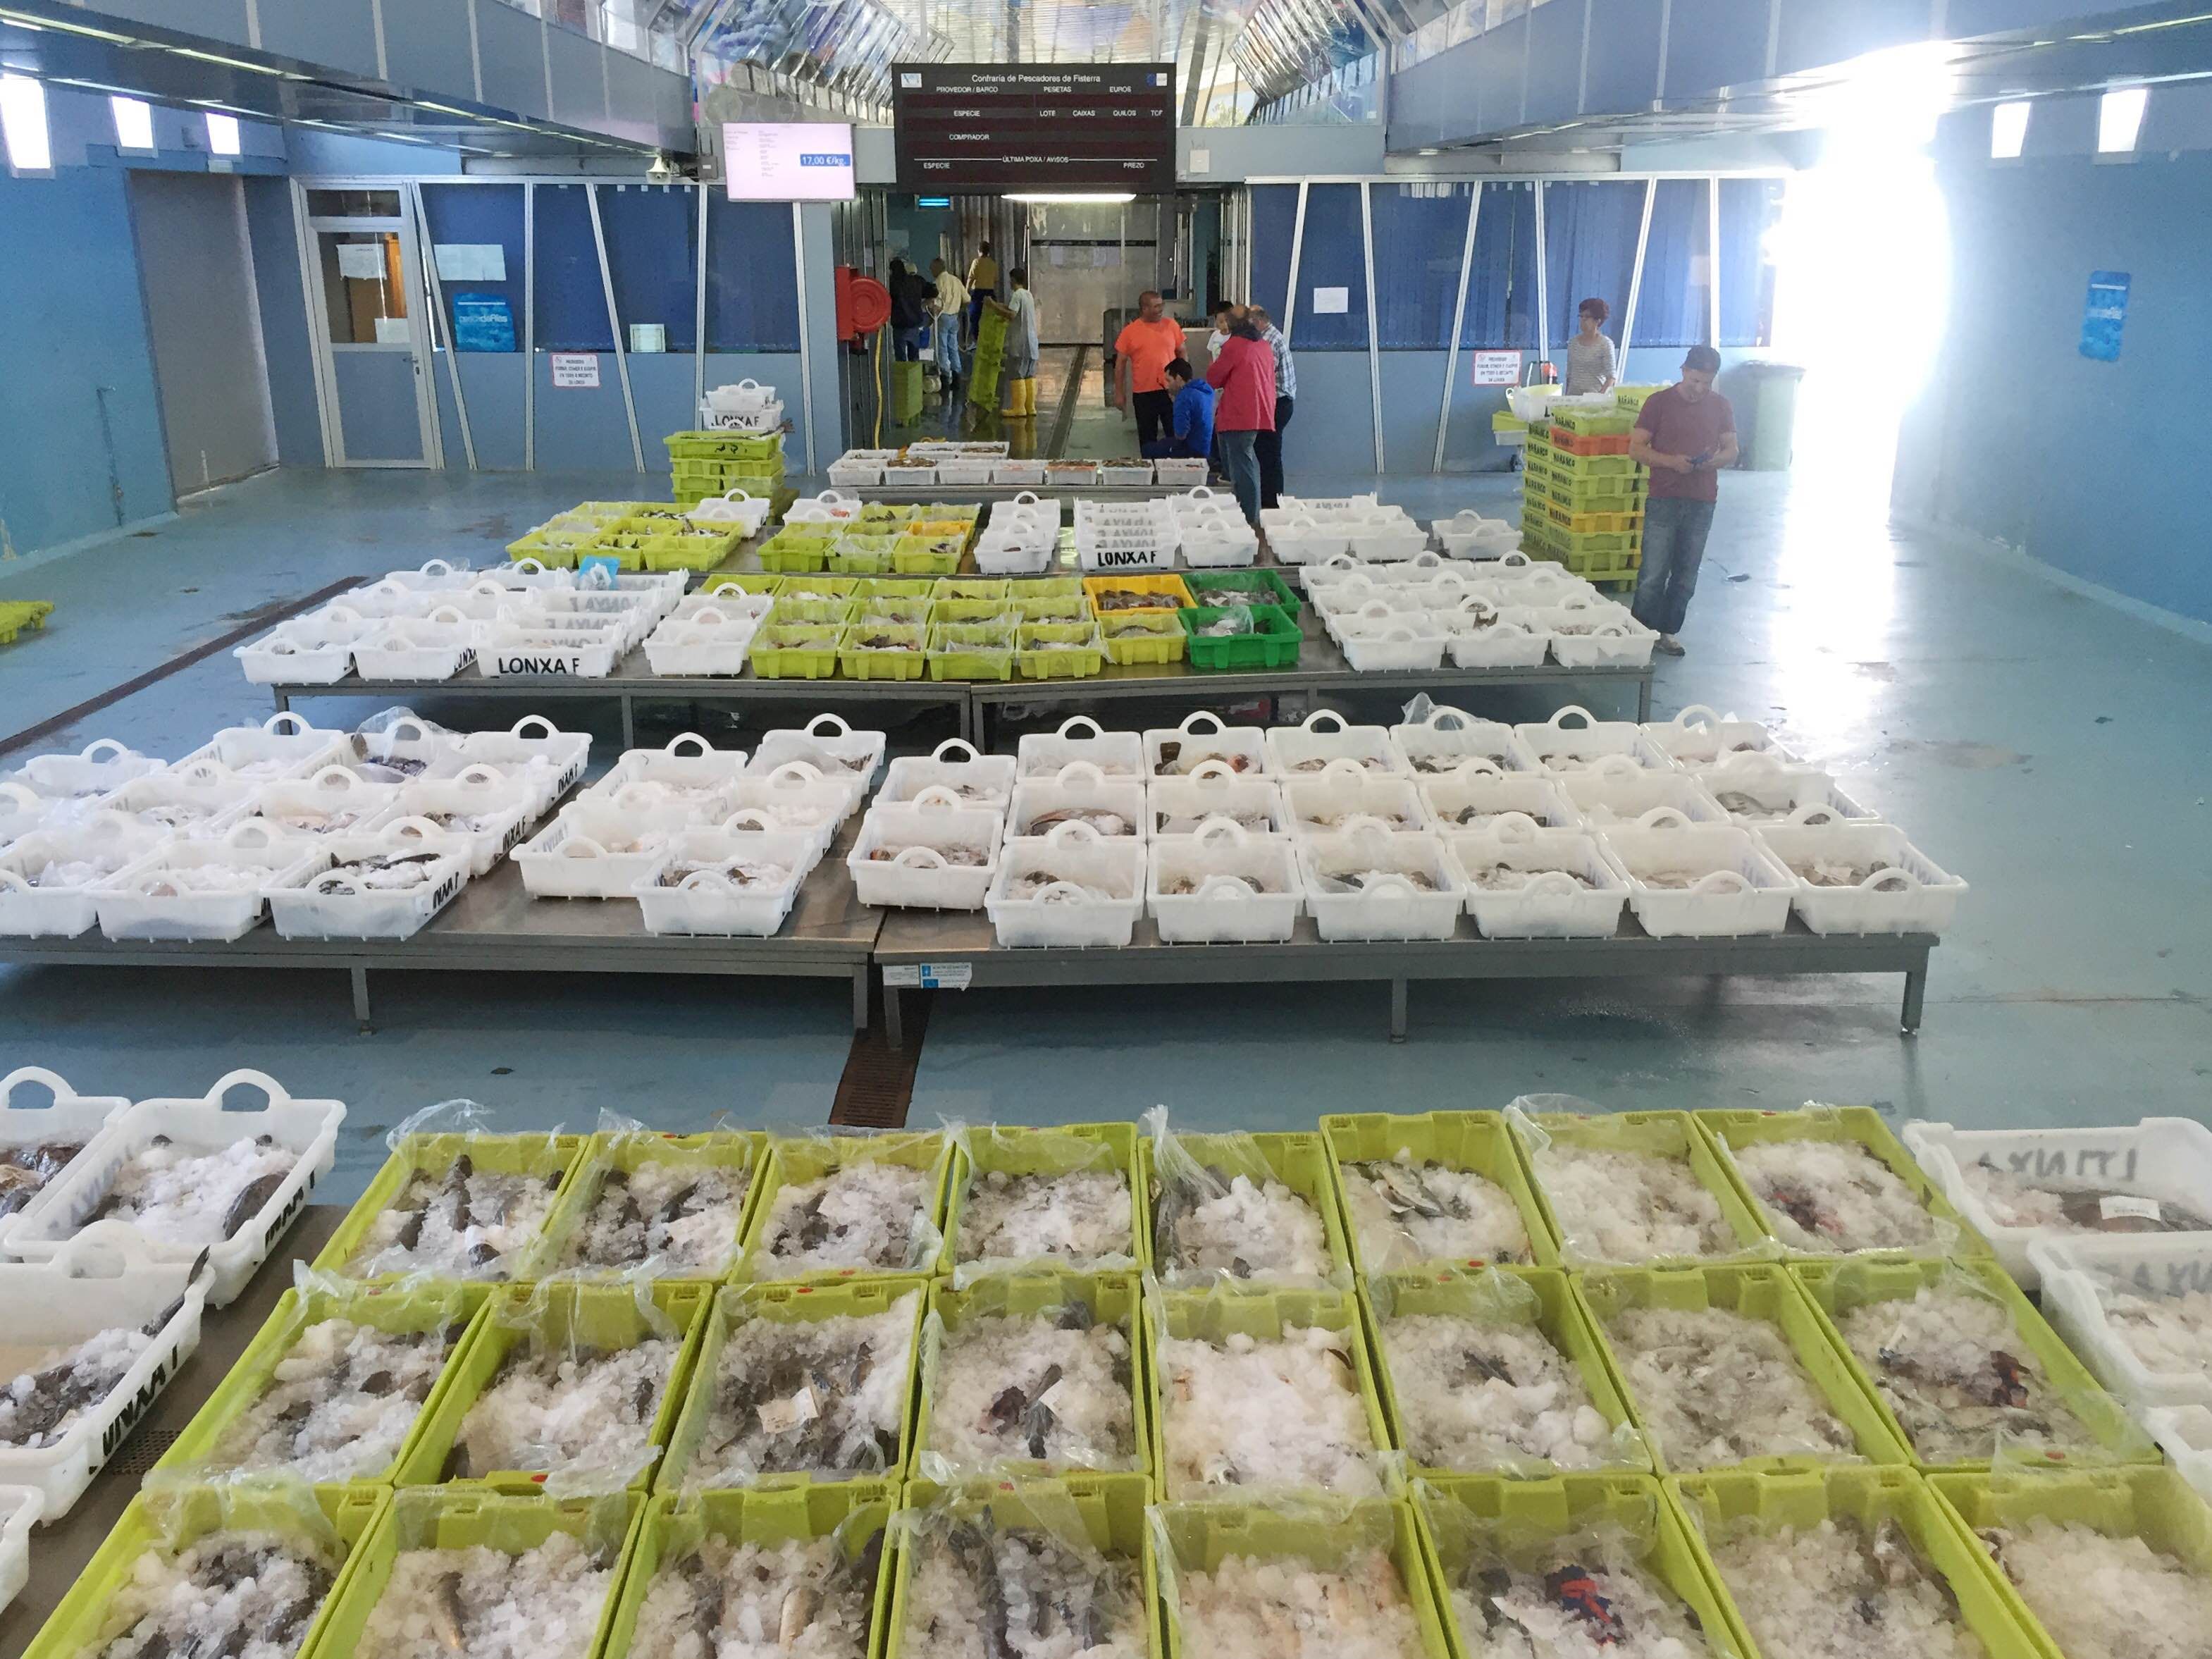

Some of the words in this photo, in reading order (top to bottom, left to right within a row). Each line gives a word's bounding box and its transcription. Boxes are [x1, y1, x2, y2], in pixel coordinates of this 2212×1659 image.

[1007, 74, 1016, 82] de
[1018, 74, 1061, 82] Pescadores
[1062, 74, 1071, 82] de
[1073, 74, 1101, 82] Fisterra
[802, 156, 824, 166] 17,00
[1097, 551, 1147, 567] LONXA
[1150, 550, 1158, 563] F
[498, 657, 567, 674] LONXA
[572, 658, 581, 674] F
